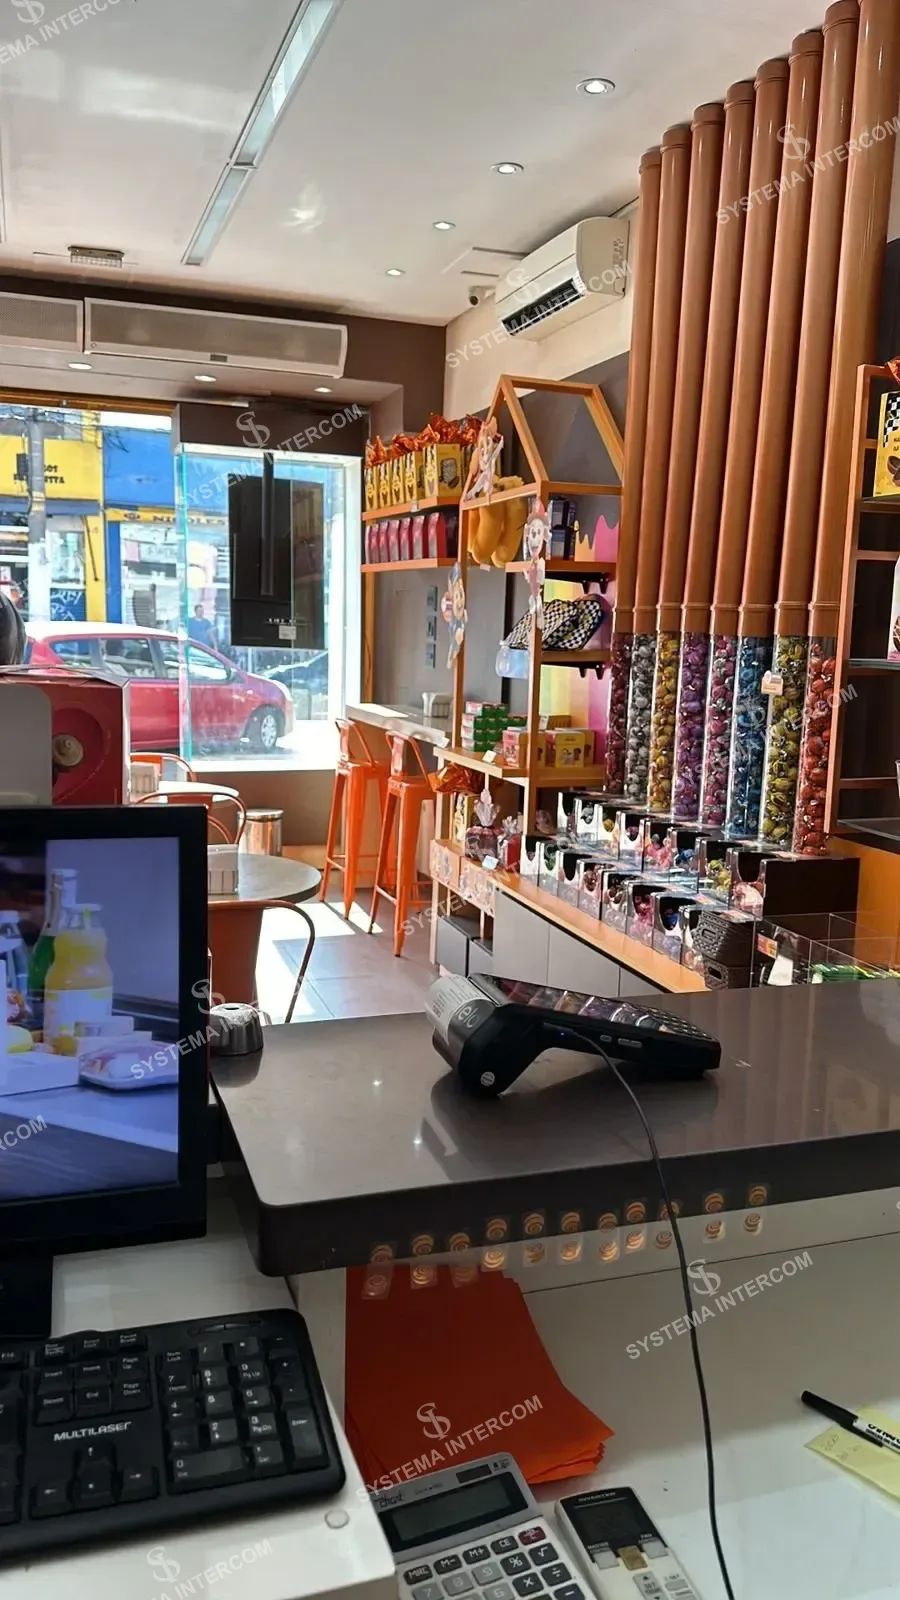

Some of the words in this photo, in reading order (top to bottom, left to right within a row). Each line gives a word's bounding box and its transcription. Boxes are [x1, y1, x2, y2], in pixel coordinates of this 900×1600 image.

[53, 1420, 133, 1442] MULTILASER
[498, 1539, 512, 1548] CE
[468, 1547, 485, 1558] M+
[408, 1566, 430, 1580] MRC
